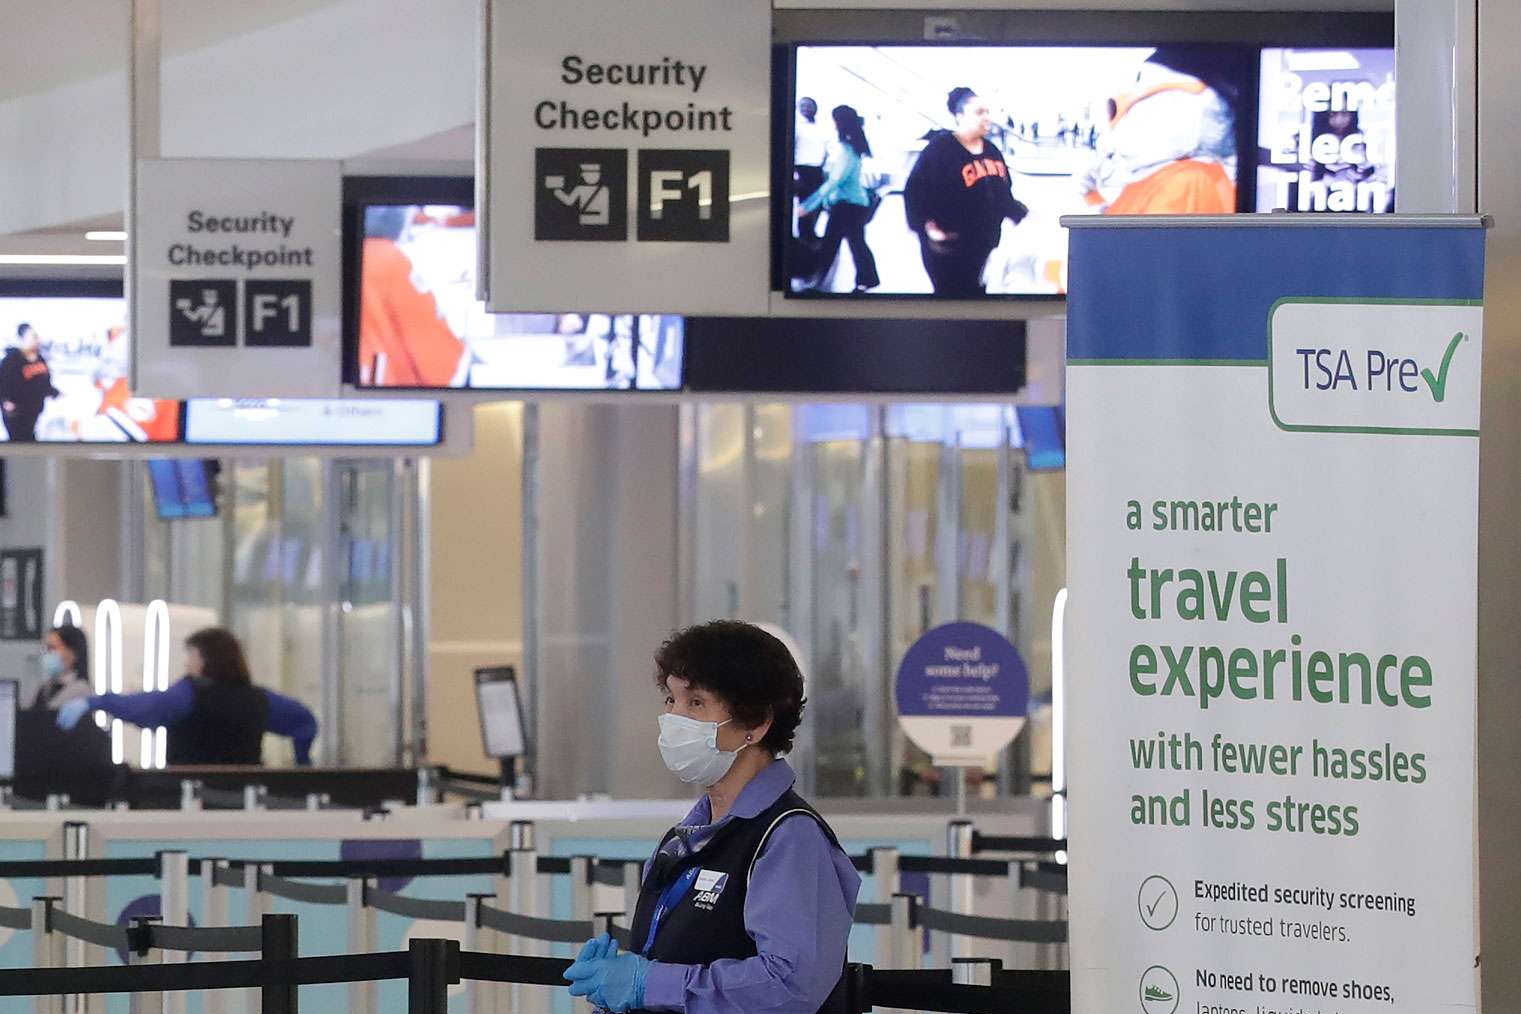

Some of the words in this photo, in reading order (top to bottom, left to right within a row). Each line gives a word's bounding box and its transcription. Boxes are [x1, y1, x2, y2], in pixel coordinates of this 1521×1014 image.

[561, 55, 707, 93] Security
[534, 101, 732, 138] Checkpoint
[650, 170, 712, 220] F1
[187, 211, 294, 239] Security
[167, 245, 313, 272] Checkpoint
[253, 296, 302, 332] F1
[1296, 347, 1357, 392] TSA
[1367, 348, 1419, 393] Pre
[1126, 498, 1142, 530] a
[1152, 496, 1278, 533] smarter
[1127, 556, 1289, 624] travel
[1129, 634, 1433, 709] experience
[1130, 731, 1203, 771] with
[1211, 733, 1303, 776] fewer
[1312, 739, 1427, 783] hassles
[1130, 789, 1190, 826] and
[1203, 790, 1255, 830] less
[1266, 796, 1359, 836] stress
[1194, 880, 1268, 904] Expedited
[1274, 886, 1334, 910] security
[1340, 891, 1416, 916] screening
[1195, 912, 1217, 932] for
[1220, 916, 1273, 936] trusted
[1280, 919, 1350, 943] travelers.
[1196, 969, 1217, 988] No
[1219, 973, 1253, 992] need
[1259, 975, 1276, 993] to
[1282, 978, 1338, 998] remove
[1342, 980, 1394, 1004] shoes,
